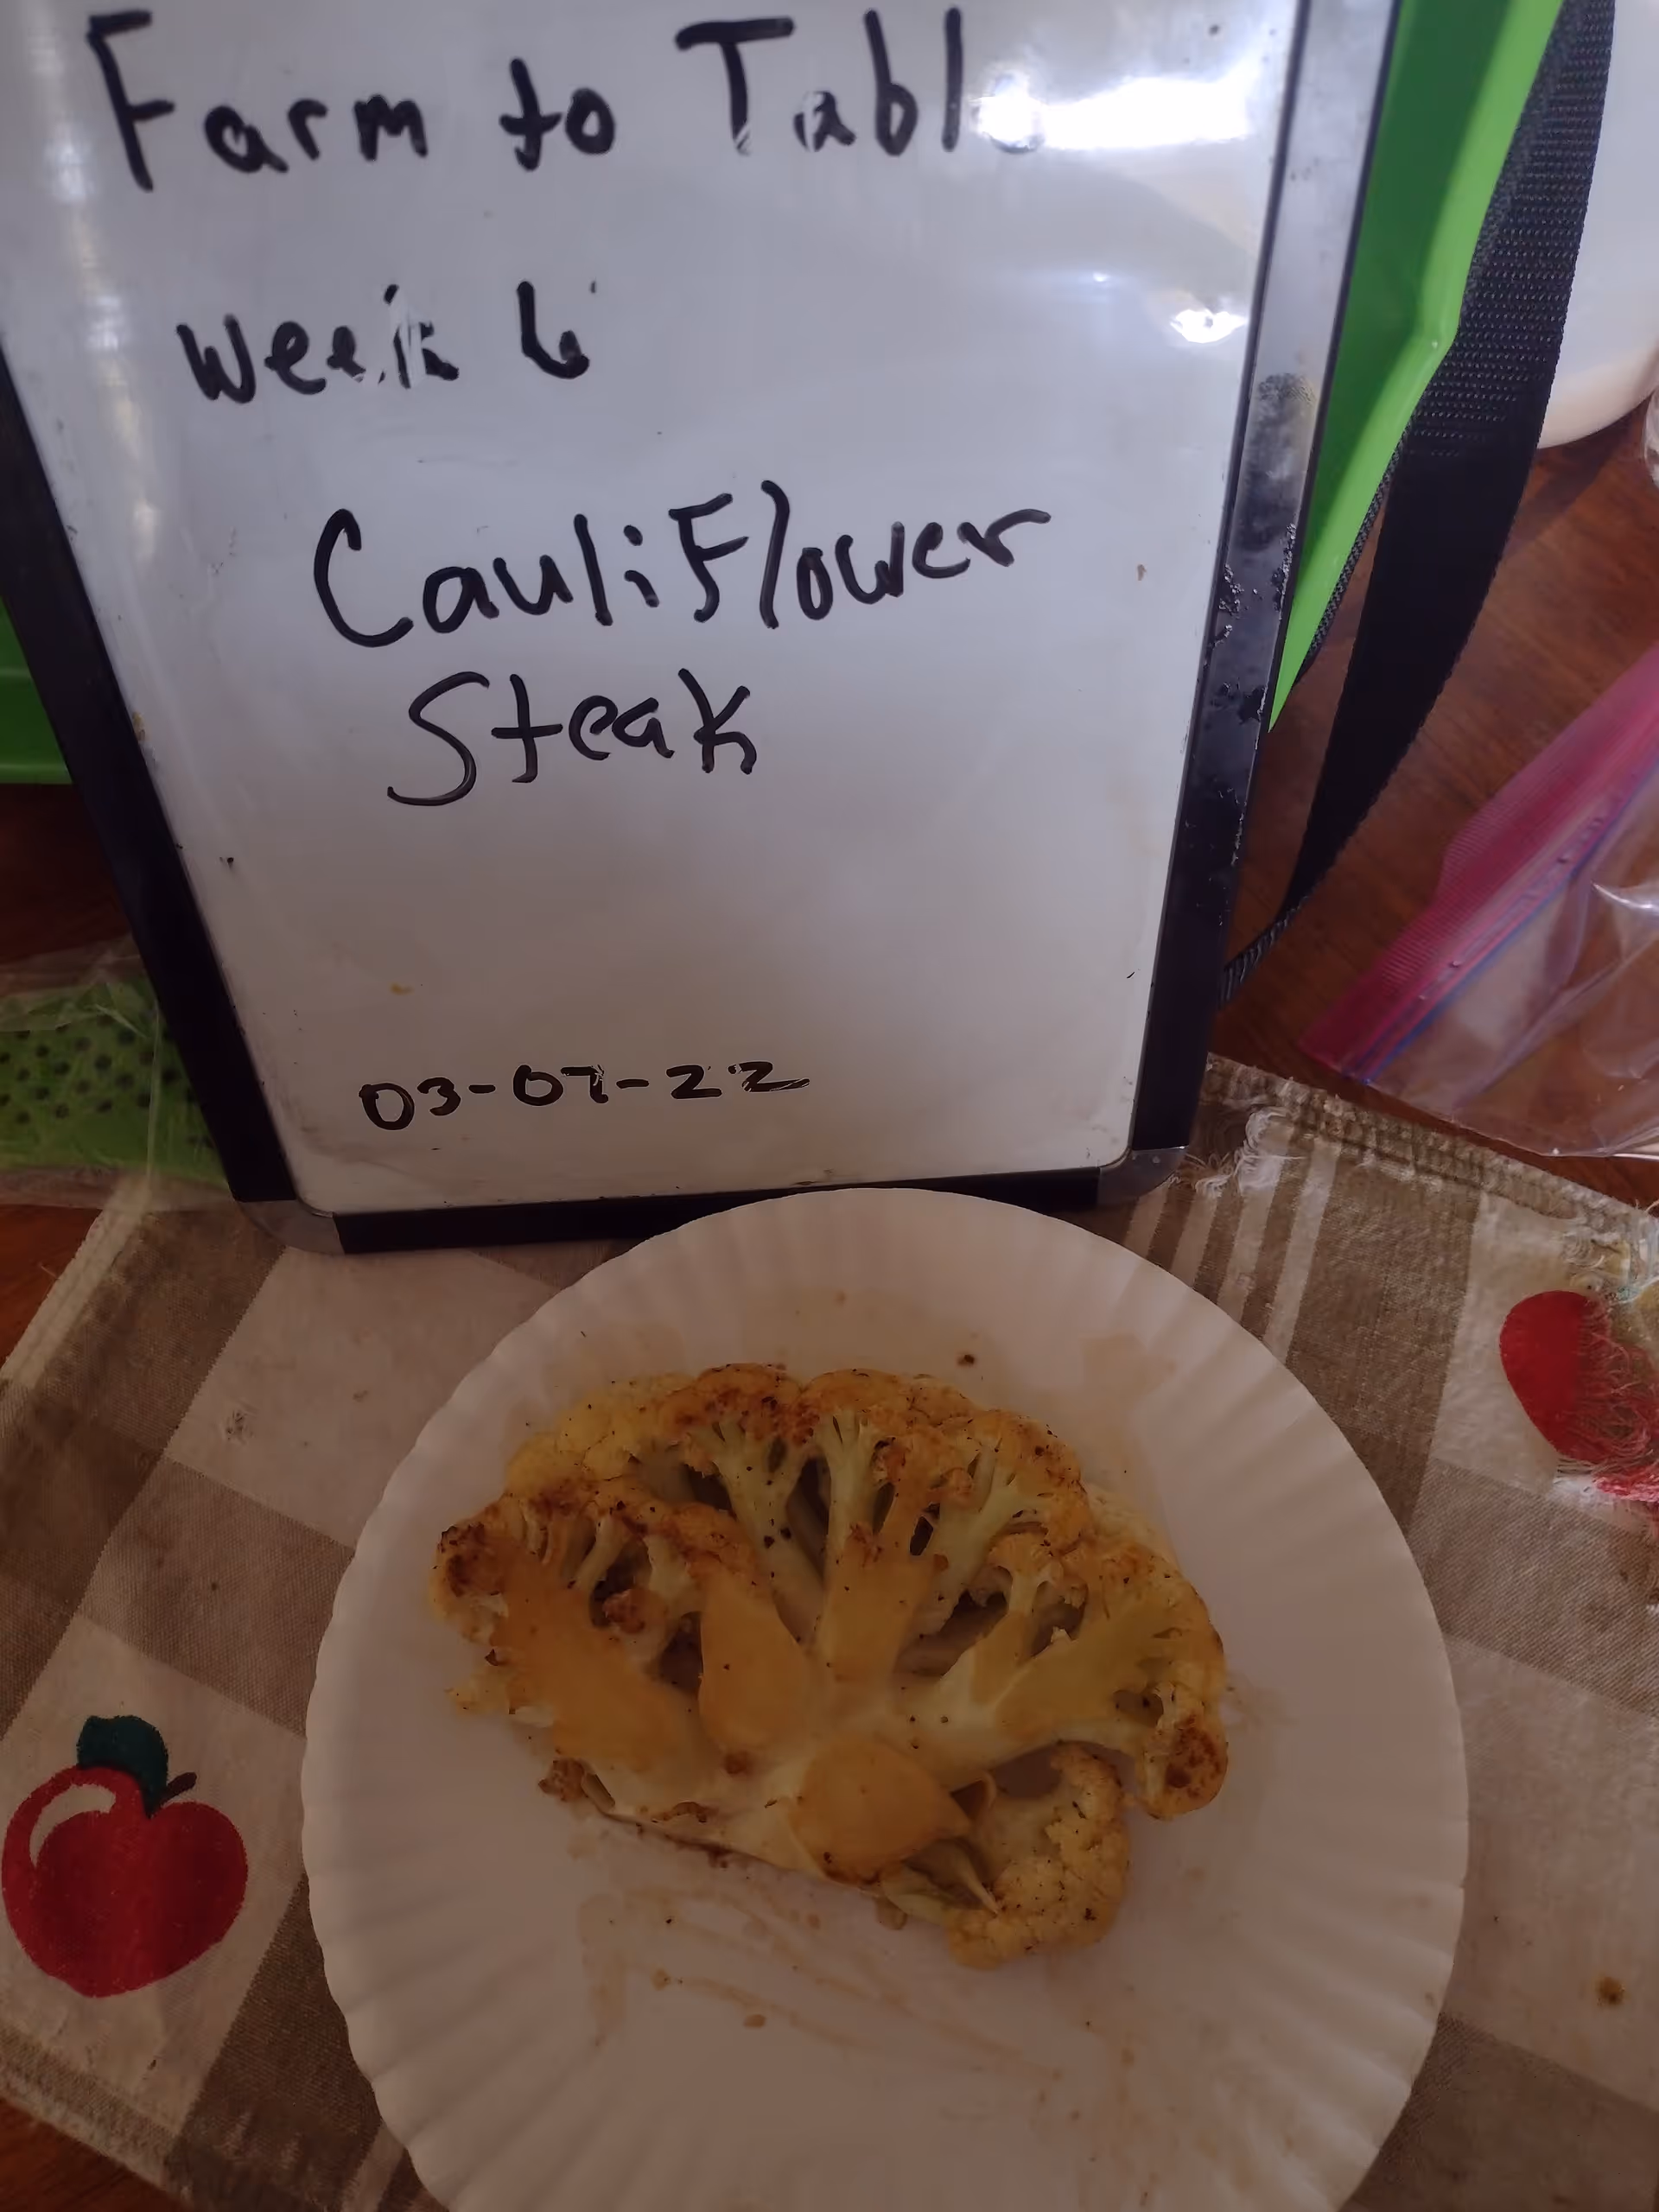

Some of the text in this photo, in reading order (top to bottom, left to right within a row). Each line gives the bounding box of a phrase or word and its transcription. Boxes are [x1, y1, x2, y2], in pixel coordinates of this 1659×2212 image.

[86, 8, 1042, 193] Farm to Tabl
[387, 668, 758, 806] Steak
